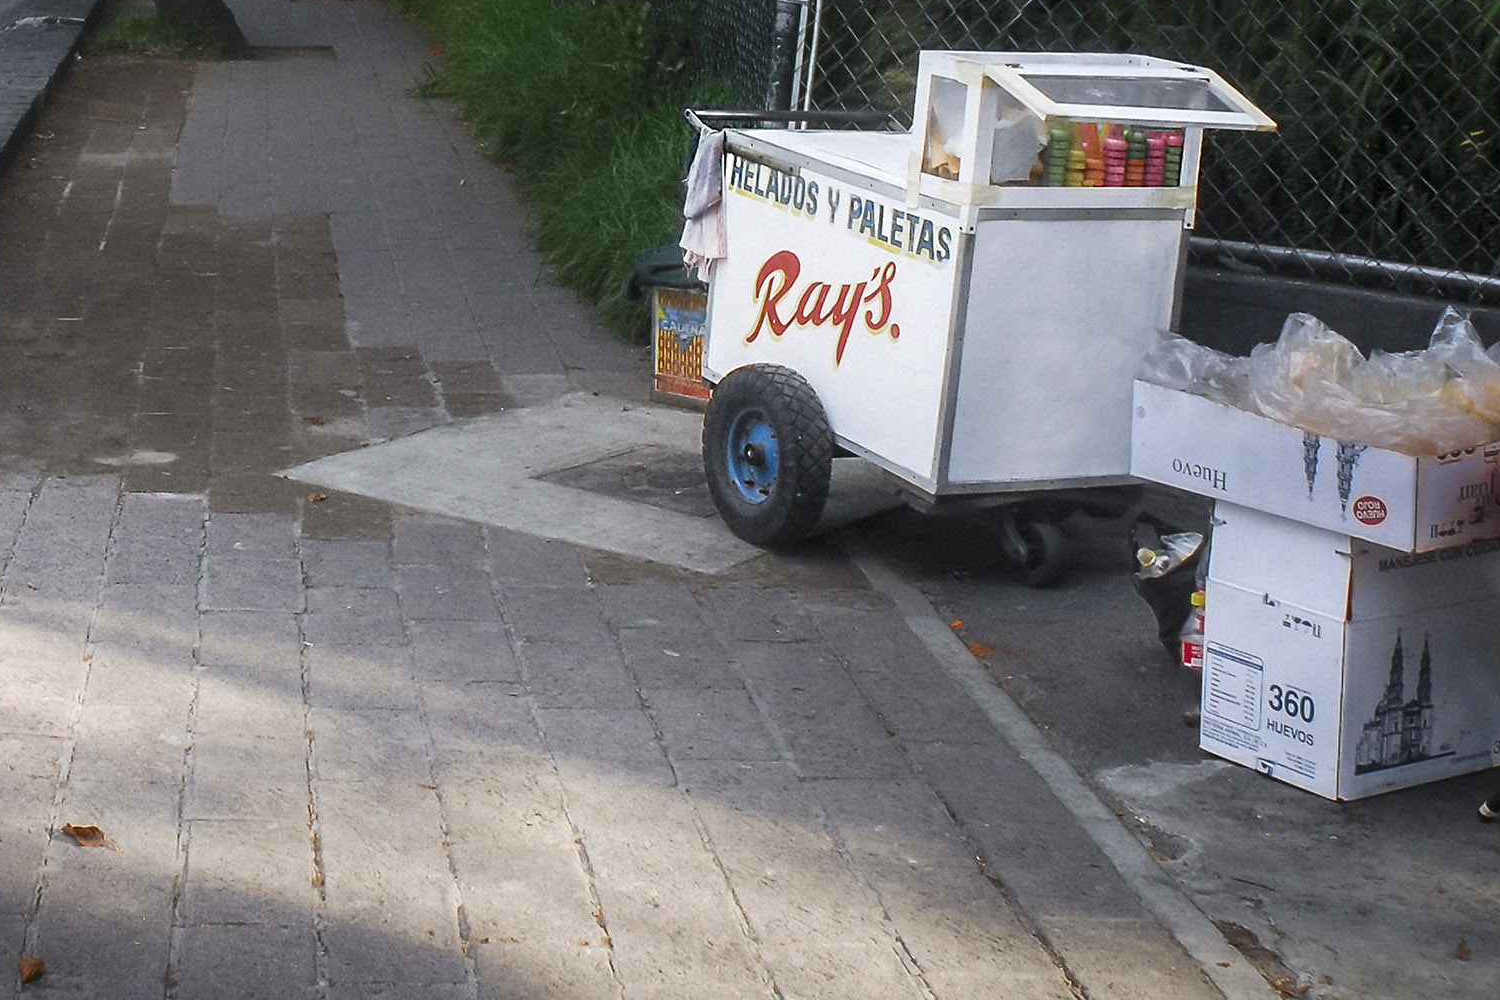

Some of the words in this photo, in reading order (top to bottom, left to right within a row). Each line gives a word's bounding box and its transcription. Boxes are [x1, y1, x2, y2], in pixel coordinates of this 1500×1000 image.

[729, 154, 819, 216] HELADOS
[827, 186, 840, 223] Y
[847, 194, 952, 263] PALETAS
[1172, 458, 1227, 491] Huevo
[1356, 509, 1386, 519] HUEVO
[1357, 500, 1380, 510] ROJO
[1268, 684, 1315, 723] 360
[1267, 719, 1314, 746] HUEVOS
